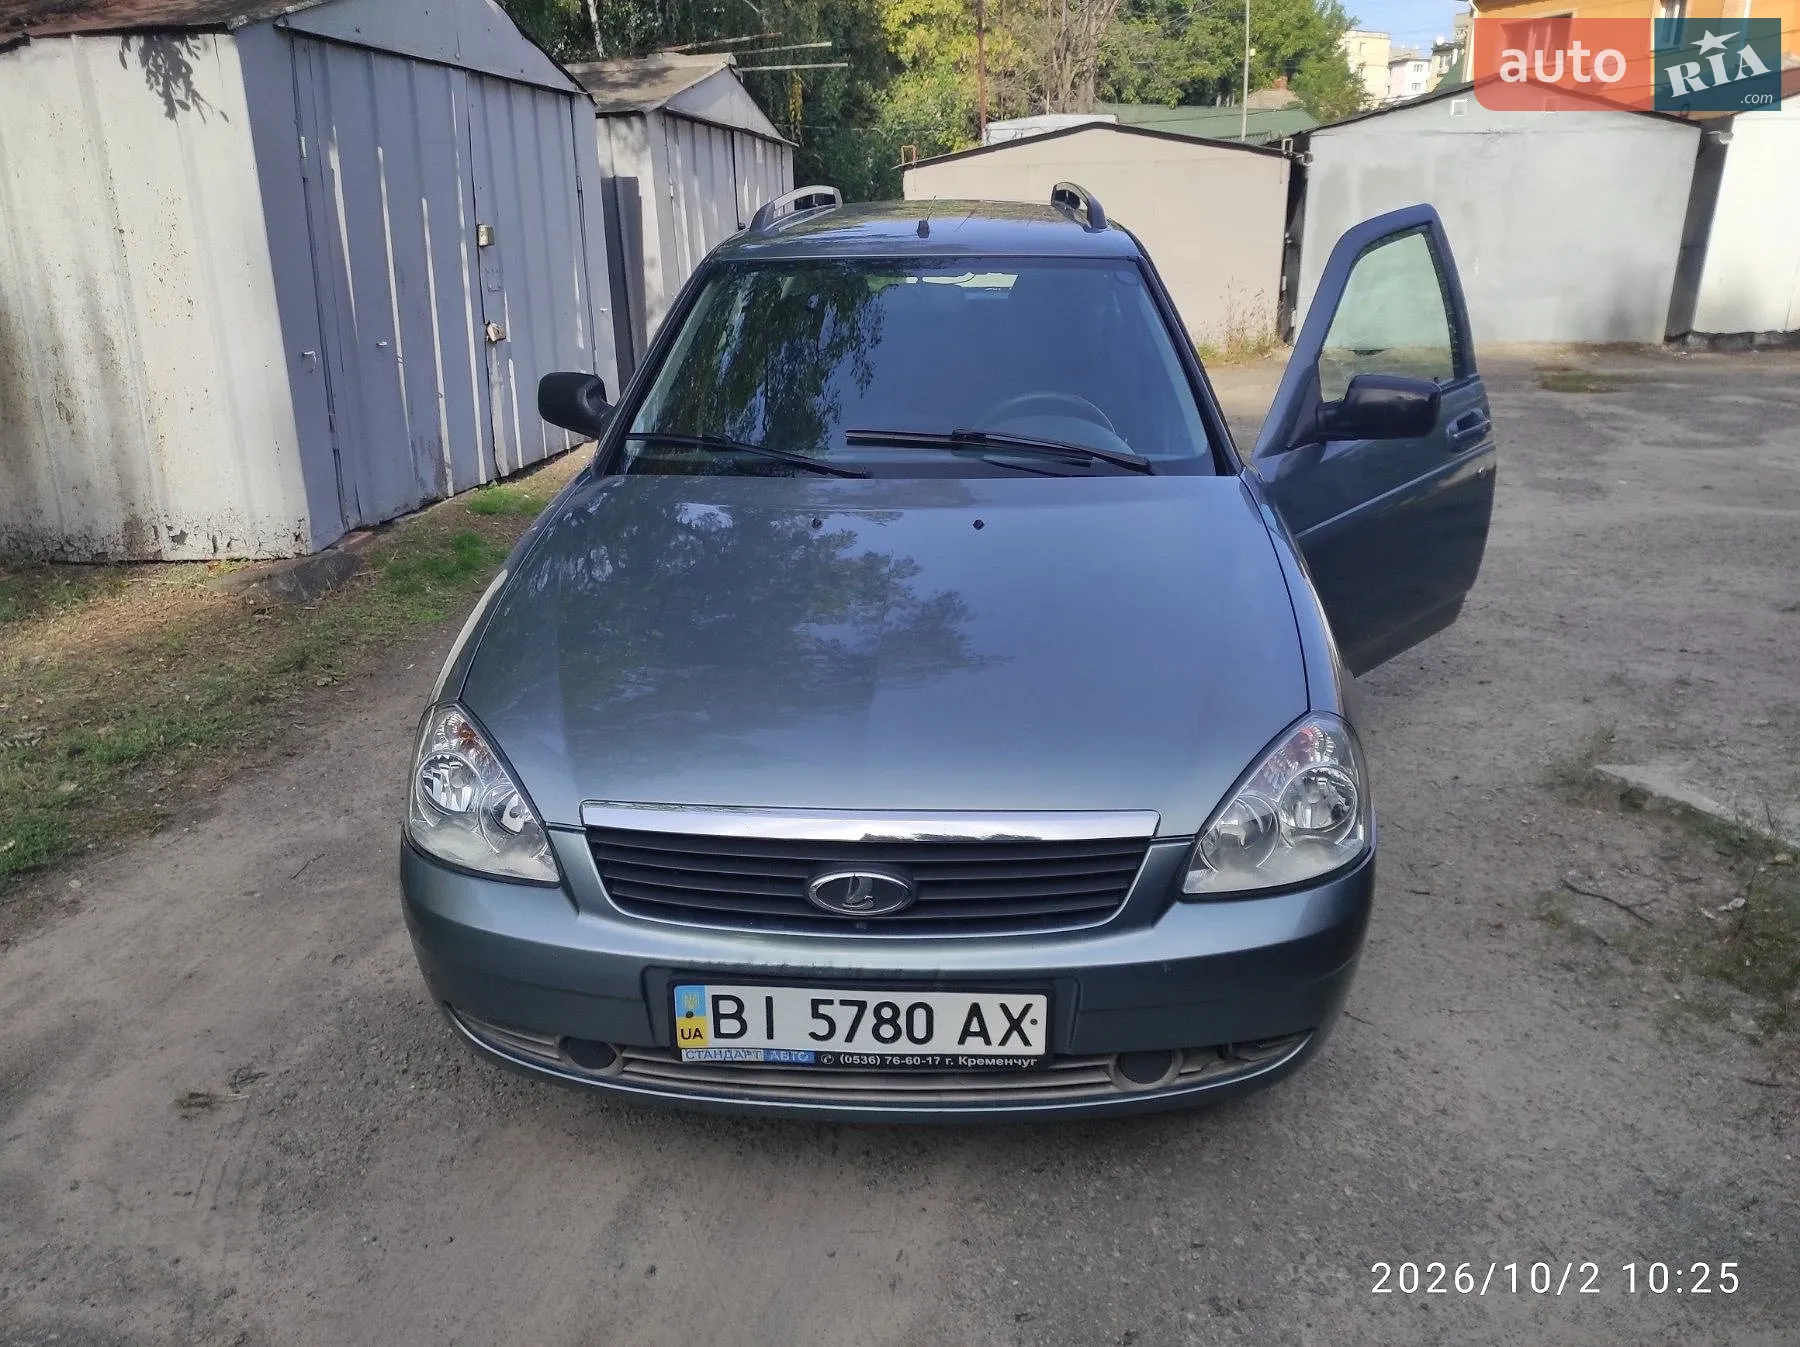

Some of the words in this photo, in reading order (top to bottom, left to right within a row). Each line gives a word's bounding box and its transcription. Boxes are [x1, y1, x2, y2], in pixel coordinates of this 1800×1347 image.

[711, 994, 774, 1040] BI
[808, 998, 935, 1045] 5780
[957, 1002, 1033, 1047] AX
[680, 1027, 704, 1041] UA
[685, 1050, 761, 1062] СТАНДАРТ
[769, 1051, 810, 1062] АВТО
[839, 1055, 881, 1066] (0536)
[885, 1056, 941, 1066] 76-60-17
[945, 1057, 954, 1066] г.
[958, 1056, 1038, 1068] Кременчуг
